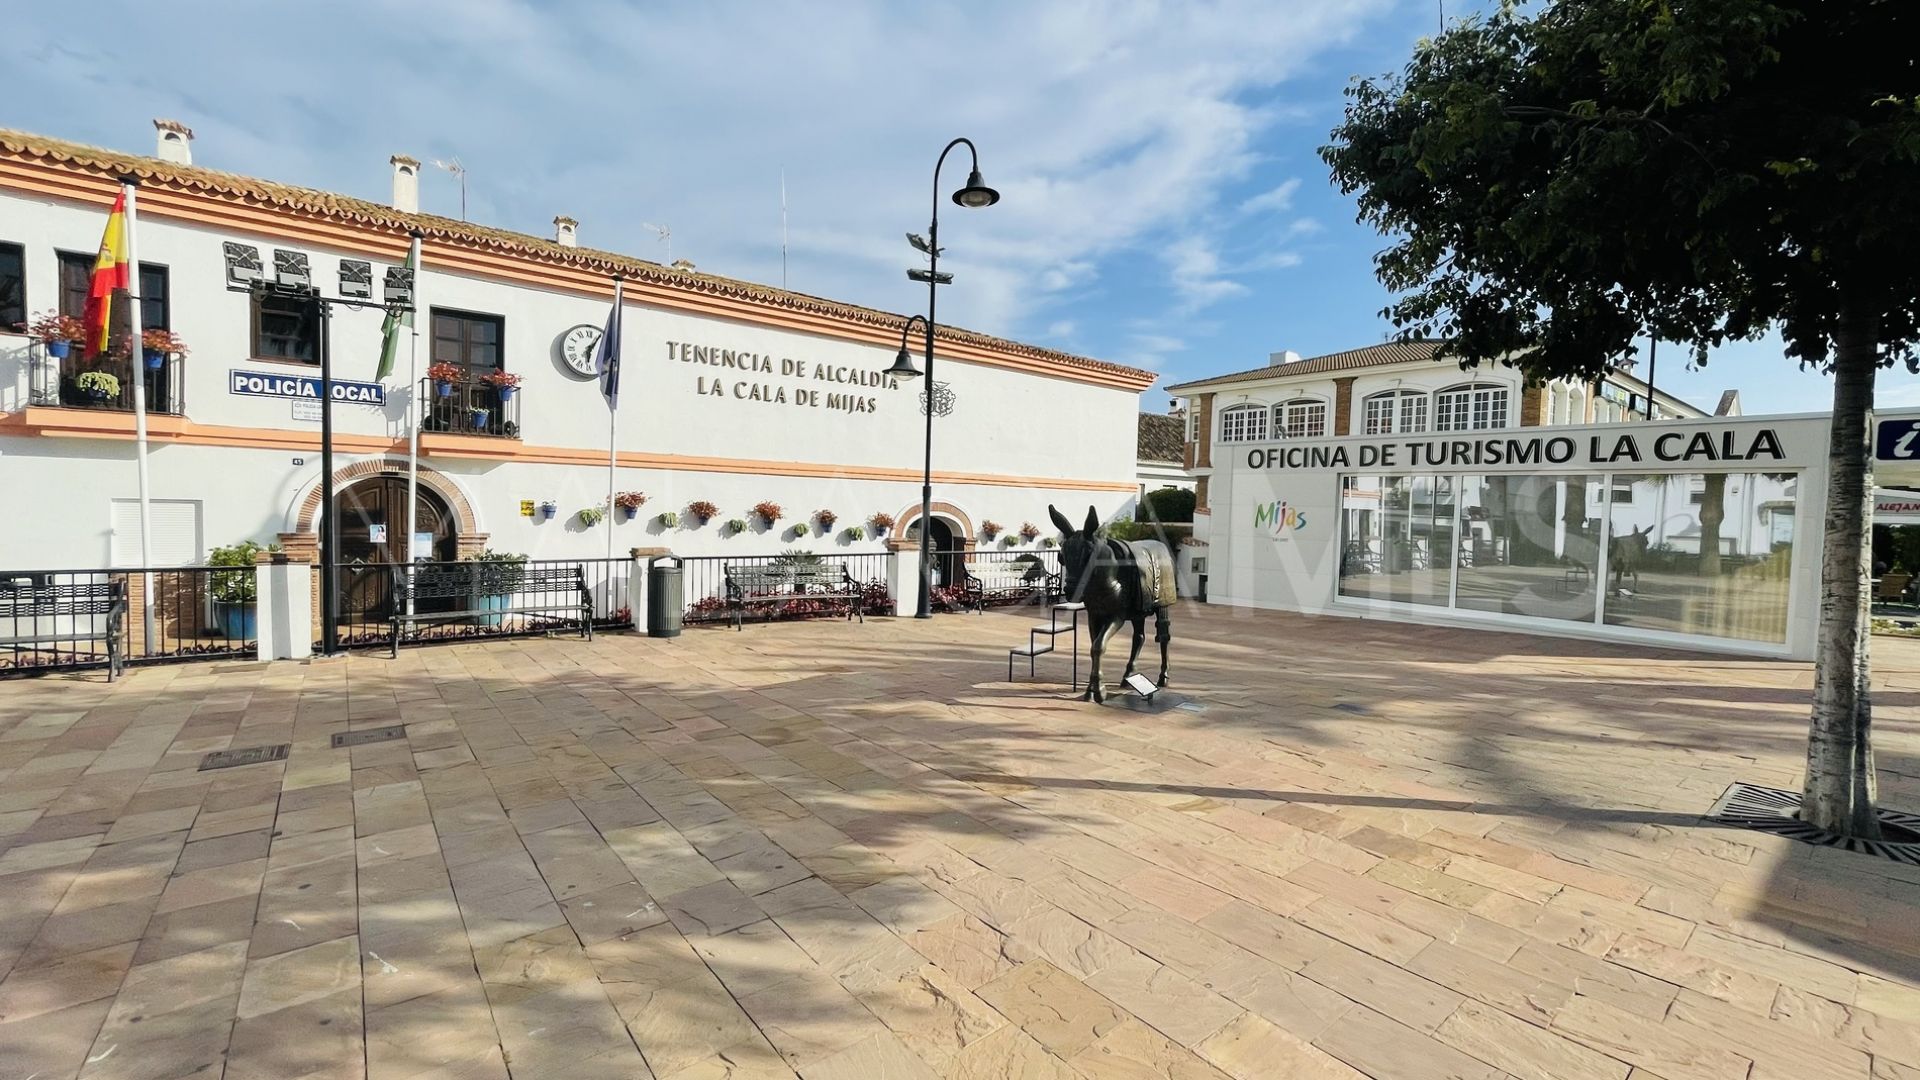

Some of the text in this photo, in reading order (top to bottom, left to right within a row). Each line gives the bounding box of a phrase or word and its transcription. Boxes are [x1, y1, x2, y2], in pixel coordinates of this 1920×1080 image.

[666, 340, 773, 373] TENENCIA
[781, 358, 806, 378] DE
[235, 376, 382, 402] POLICÍA OCAL
[697, 376, 877, 415] LA CALA DE MIJAS
[1247, 429, 1787, 469] OFICINA DE TURISMO LA CALA
[1255, 500, 1307, 535] Mijas
